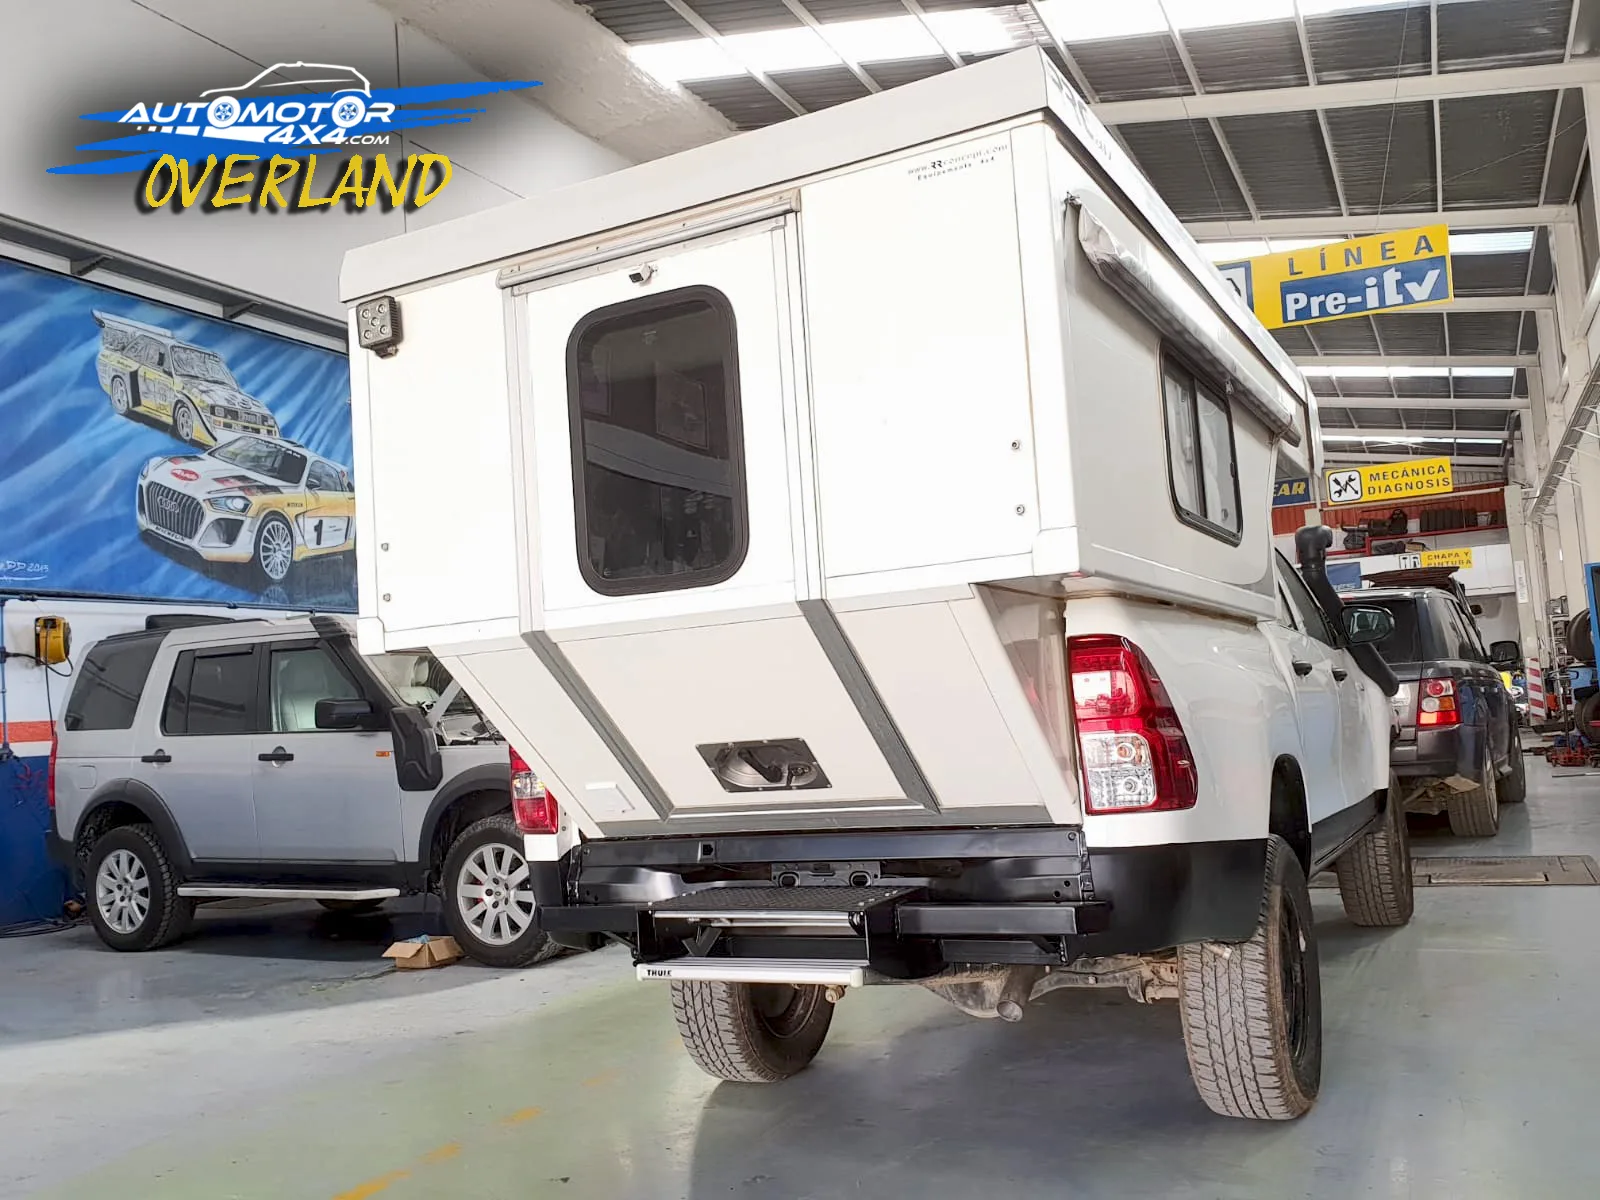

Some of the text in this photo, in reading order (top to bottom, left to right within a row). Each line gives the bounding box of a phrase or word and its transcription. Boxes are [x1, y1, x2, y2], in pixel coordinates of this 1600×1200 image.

[1288, 234, 1434, 276] LÍNEA
[1369, 464, 1446, 482] MECÁNICA
[1367, 477, 1451, 496] DIAGNOSIS
[314, 519, 323, 546] 1
